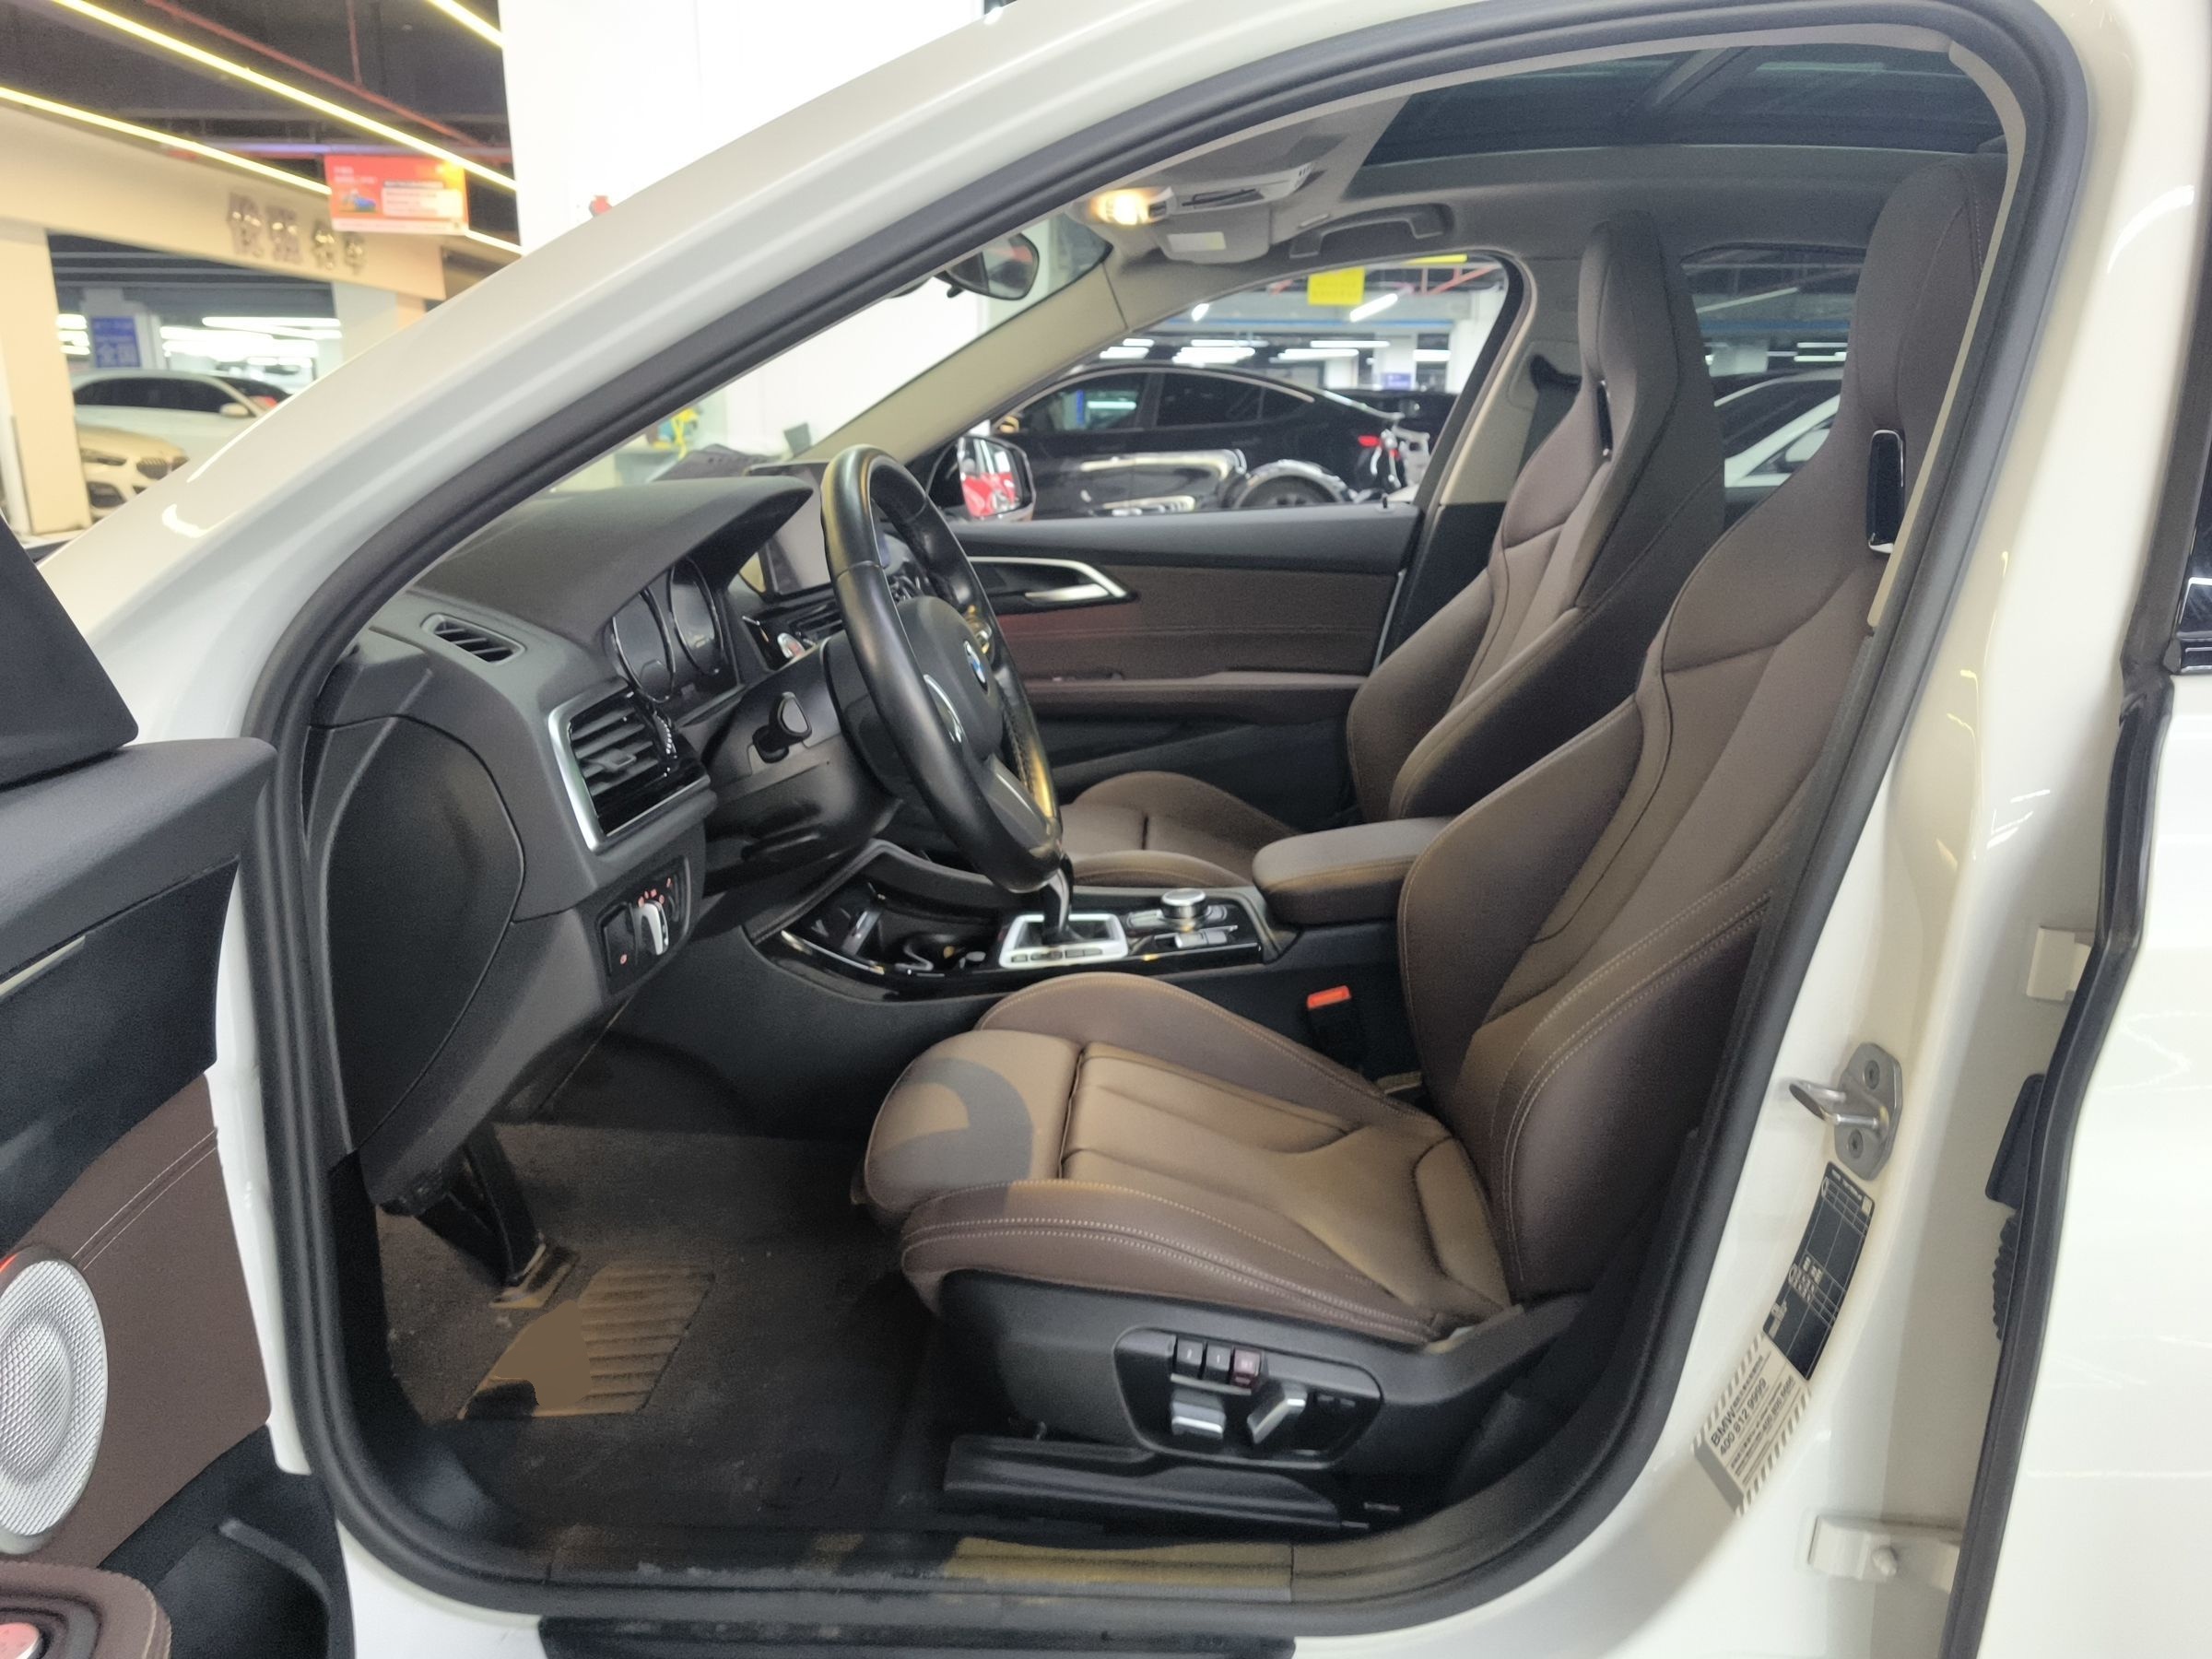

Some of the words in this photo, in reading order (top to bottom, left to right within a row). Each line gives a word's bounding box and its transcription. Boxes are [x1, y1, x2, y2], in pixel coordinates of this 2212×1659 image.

[1711, 1408, 1736, 1447] BMW
[1720, 1433, 1735, 1455] 400
[1735, 1409, 1749, 1433] 812
[1747, 1378, 1767, 1409] 9999
